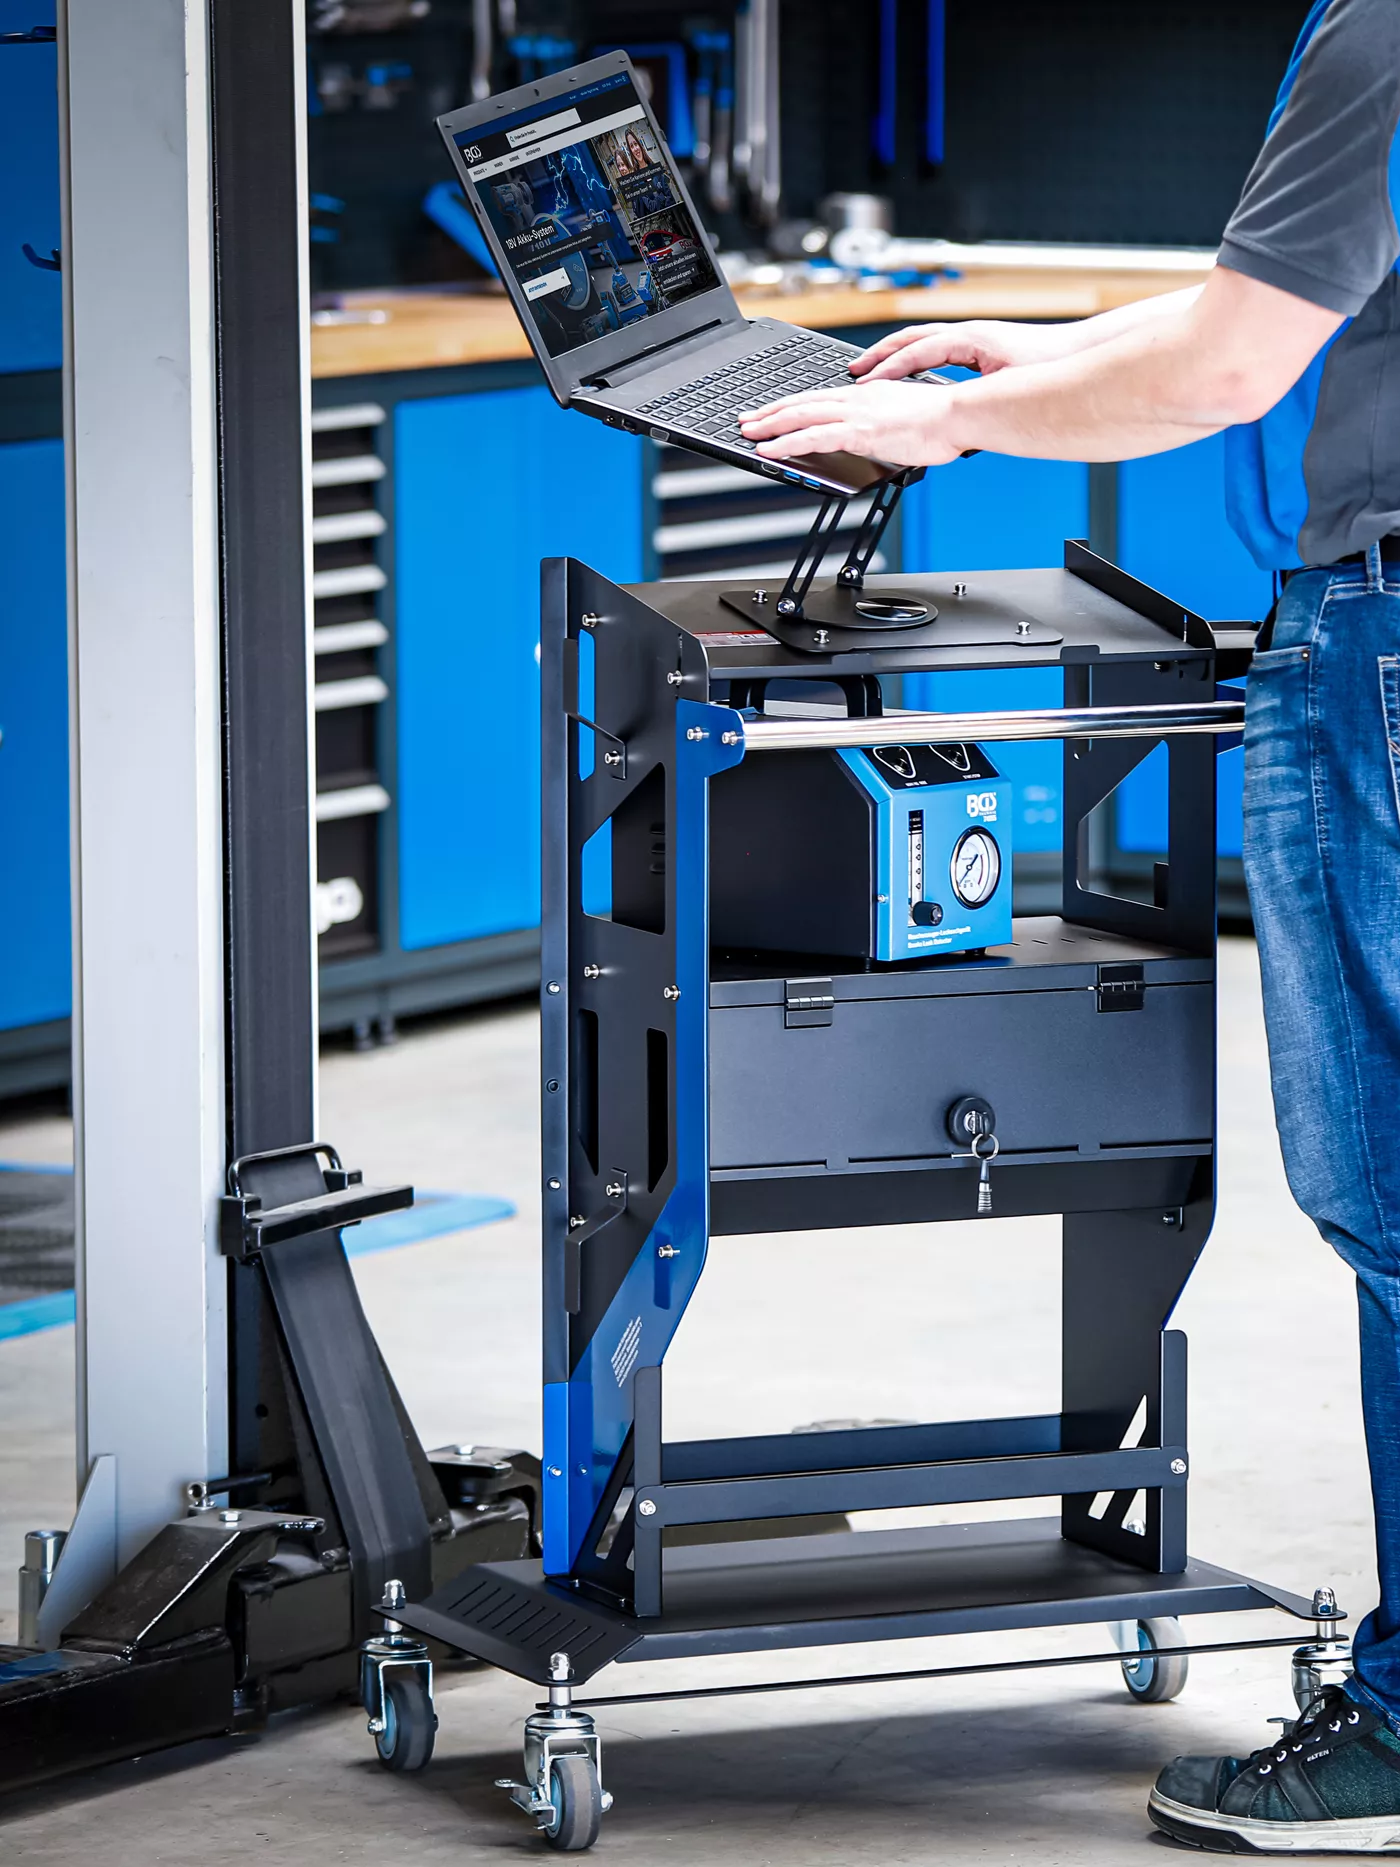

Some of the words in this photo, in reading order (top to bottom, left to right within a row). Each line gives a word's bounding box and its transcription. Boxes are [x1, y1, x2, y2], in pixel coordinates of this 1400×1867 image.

[464, 145, 482, 162] BGS
[505, 237, 517, 250] 18V
[517, 224, 555, 247] Akku-System
[966, 792, 997, 817] BGS
